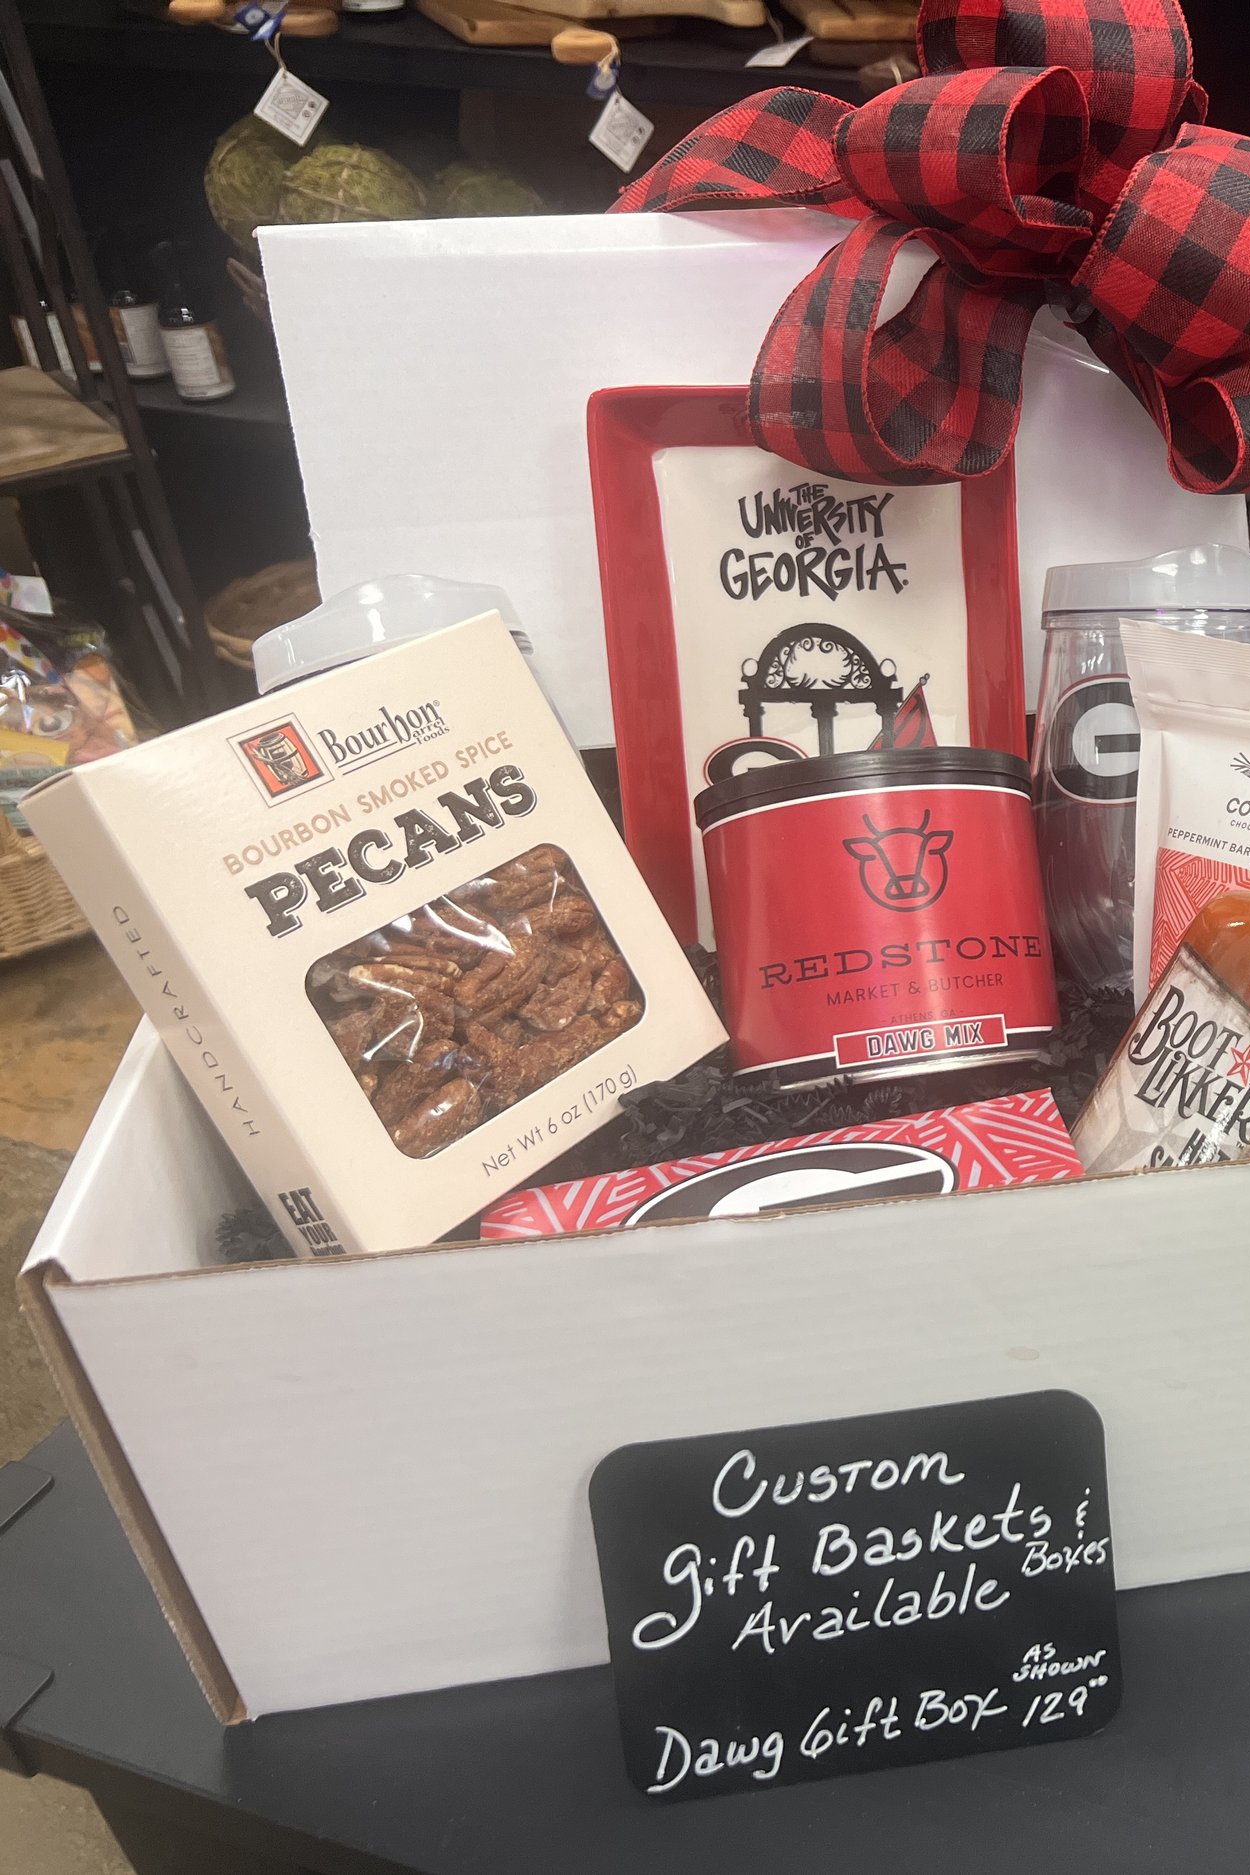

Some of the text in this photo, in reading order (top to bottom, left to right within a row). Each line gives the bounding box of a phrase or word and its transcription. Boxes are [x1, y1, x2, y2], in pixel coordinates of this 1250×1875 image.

[789, 482, 829, 506] THE
[738, 491, 895, 546] UNIVERSITY
[795, 531, 815, 549] OF
[221, 730, 514, 876] BOURBON SMOKED SPICE
[244, 764, 538, 939] PECANS
[1168, 827, 1228, 850] PEPPERMINT
[759, 935, 1042, 989] REDSTONE
[826, 972, 1004, 1007] MARKET & BUTCHER
[112, 905, 261, 1136] HANDCRAFTED
[867, 1022, 984, 1058] DAWG MIX
[1128, 985, 1244, 1070] BOOT
[481, 1063, 637, 1177] Net Wt 6 oz (170 g)
[278, 1187, 325, 1226] EAT
[297, 1222, 338, 1246] YOUR
[812, 1483, 1052, 1576] Baskets
[1022, 1537, 1109, 1577] Boxes
[732, 1563, 1010, 1653] Available
[1012, 1650, 1106, 1682] SHOWN
[1023, 1642, 1056, 1663] AS
[647, 1726, 784, 1793] Dawg
[915, 1687, 1008, 1731] Box
